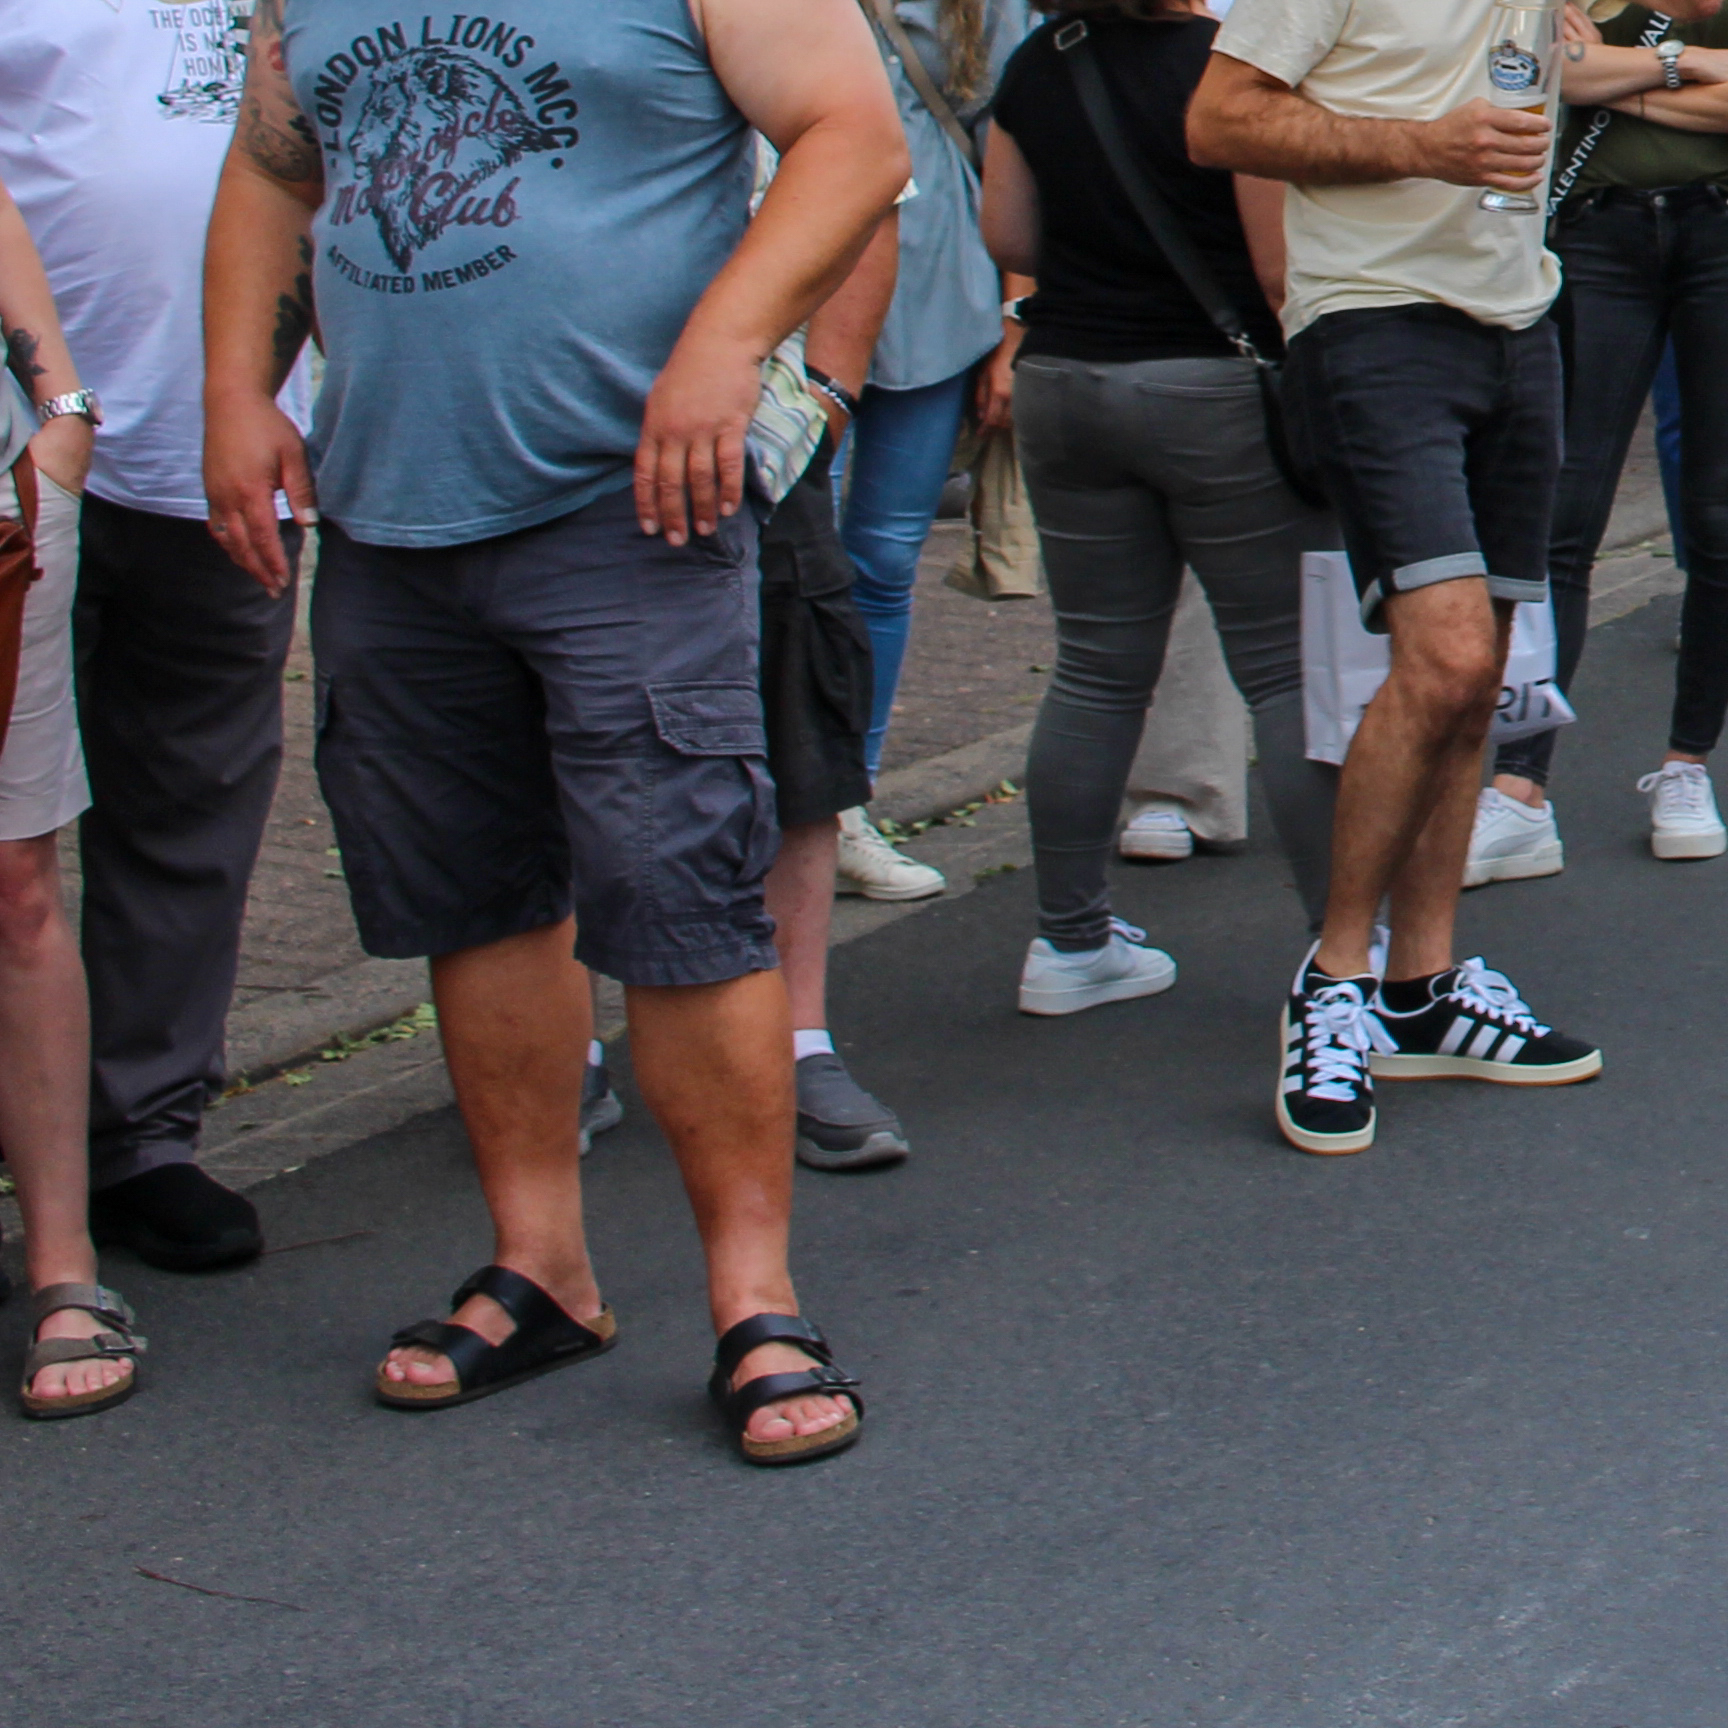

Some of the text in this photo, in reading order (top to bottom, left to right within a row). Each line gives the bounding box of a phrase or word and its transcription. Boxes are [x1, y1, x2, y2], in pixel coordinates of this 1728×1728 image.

[150, 9, 183, 29] THE
[178, 33, 198, 52] IS
[314, 22, 407, 152] LONDON
[421, 15, 535, 68] LIONS
[408, 172, 523, 228] Club
[326, 244, 518, 294] AFFILIATED MEMBER
